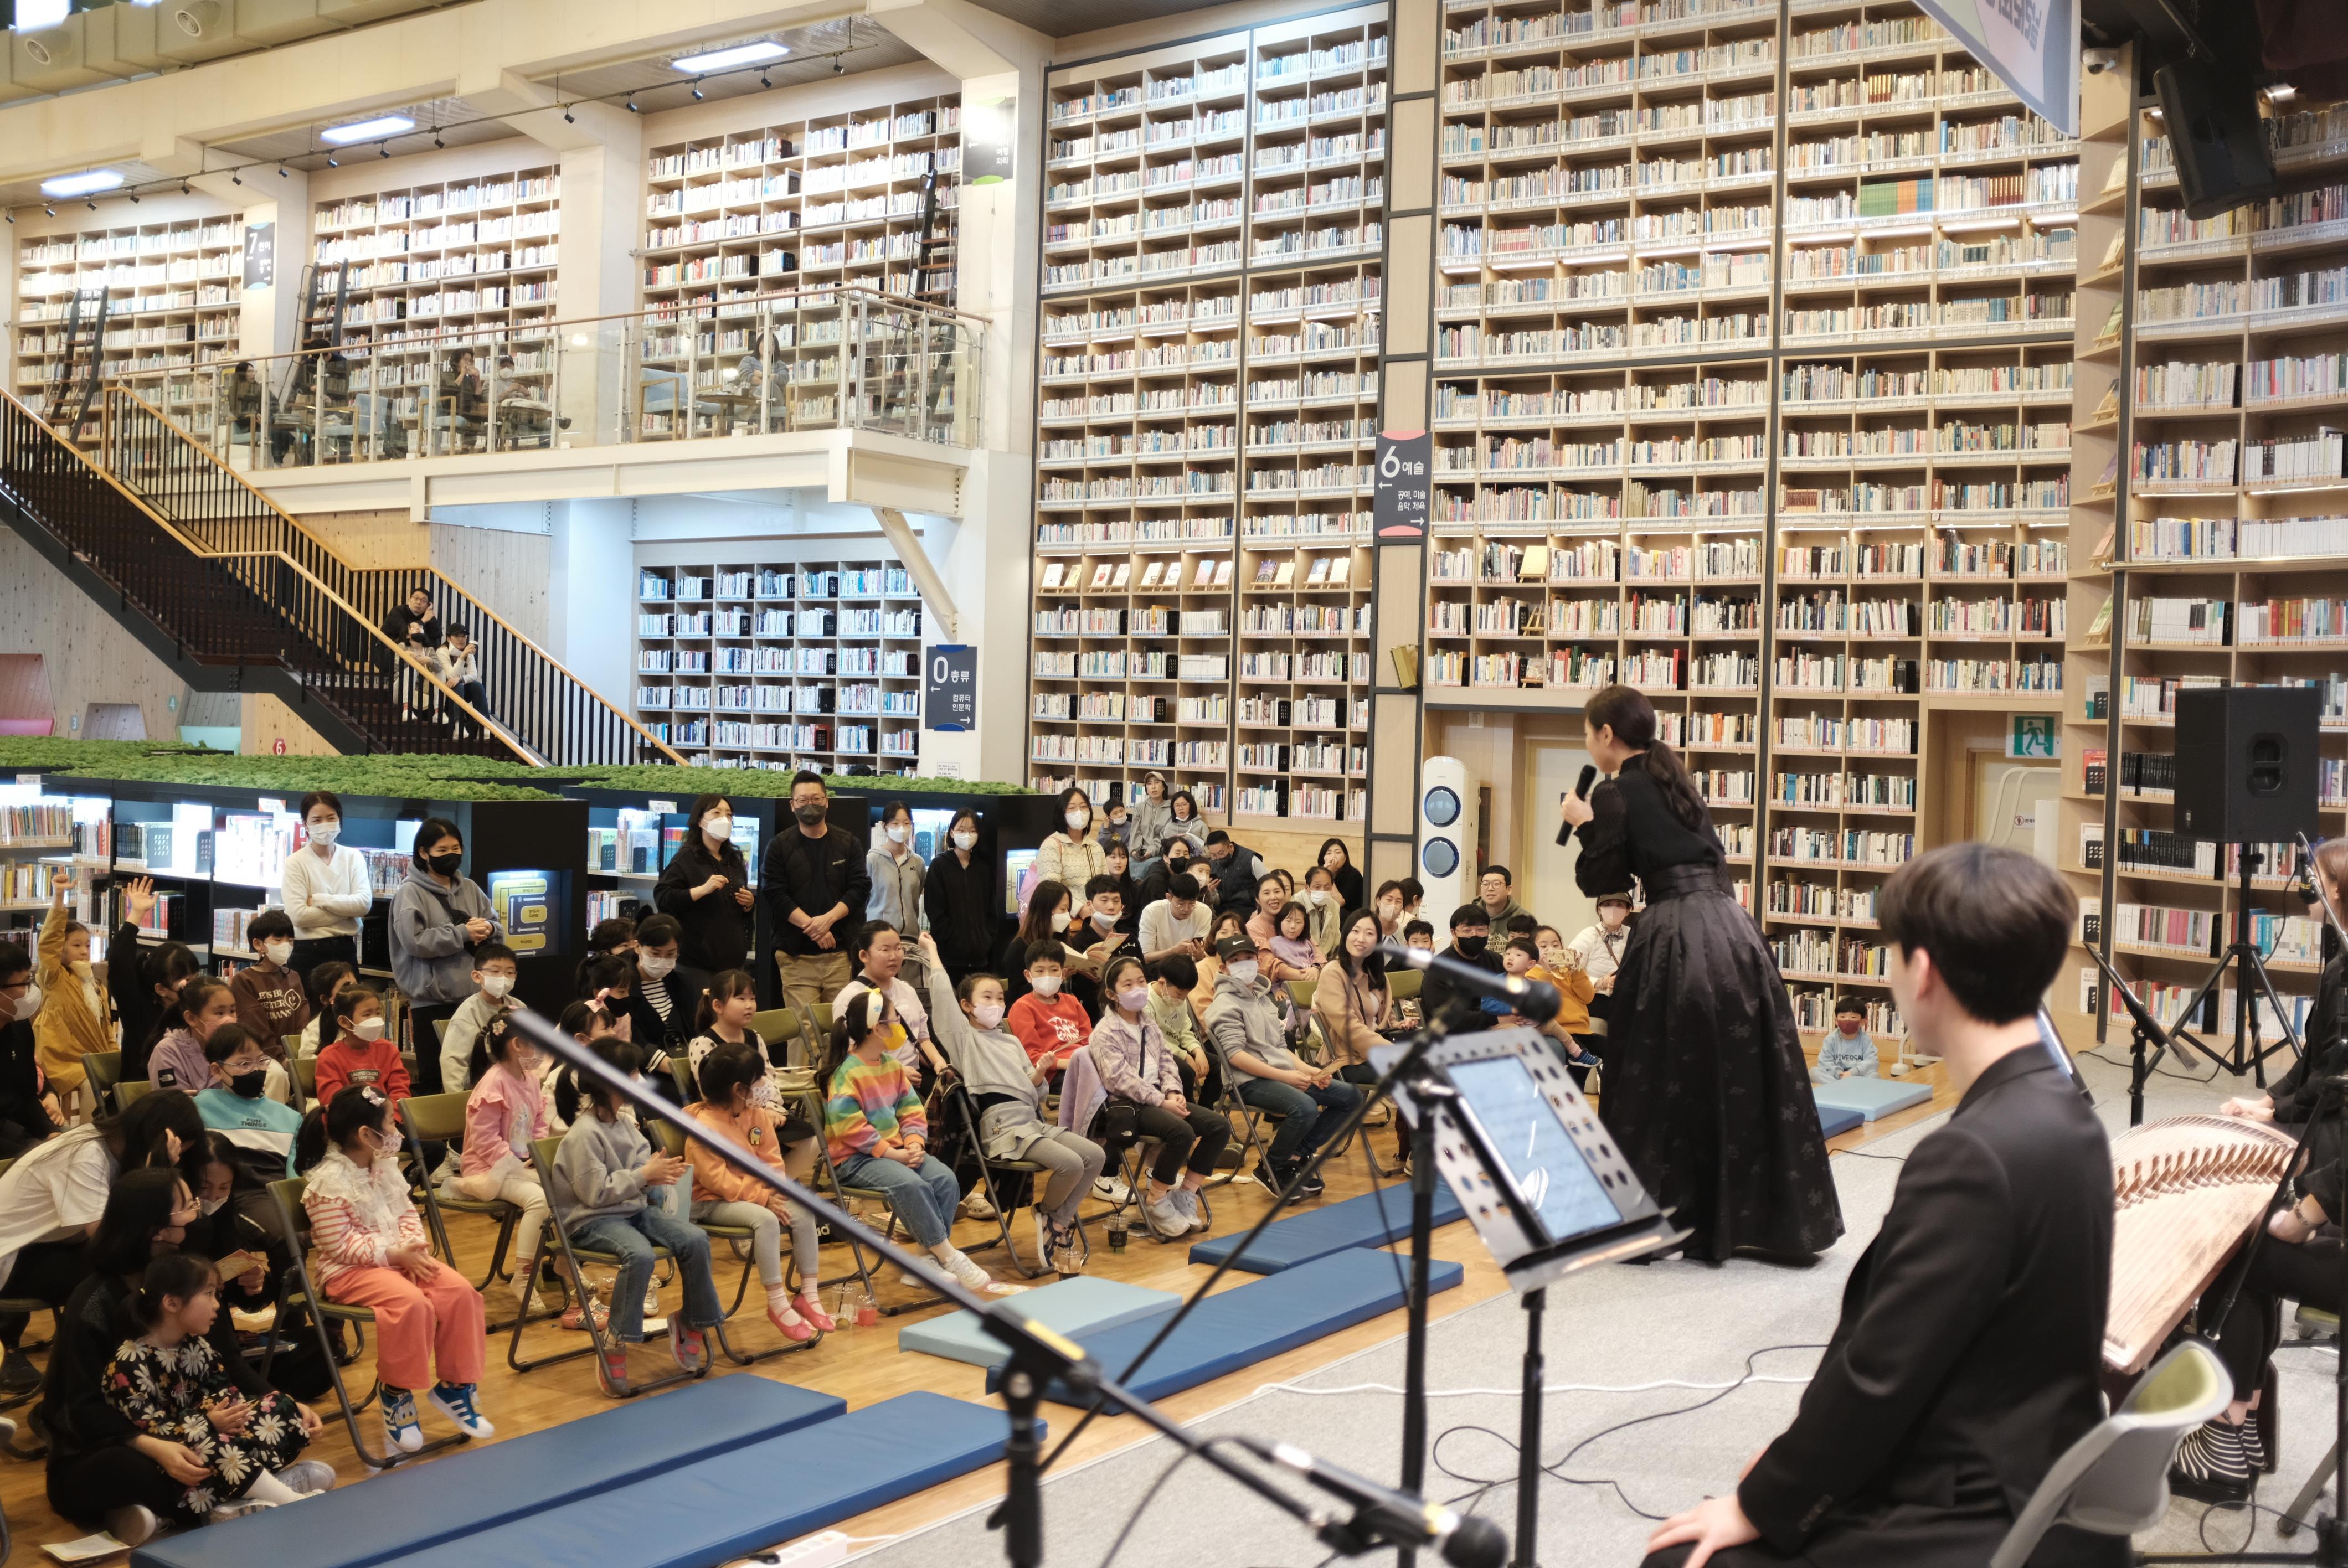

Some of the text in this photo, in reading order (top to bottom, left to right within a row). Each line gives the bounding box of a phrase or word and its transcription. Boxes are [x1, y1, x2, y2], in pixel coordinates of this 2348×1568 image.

[996, 147, 1008, 156] 여행
[996, 156, 1008, 165] 지리
[249, 233, 258, 254] 7
[1381, 445, 1424, 478] 6 예술
[1398, 489, 1426, 500] 공예, 미술
[1397, 501, 1412, 512] 음악,
[934, 656, 970, 684] 0 총류
[169, 697, 175, 709] 4
[952, 703, 971, 712] 인문학
[73, 718, 77, 729] 3
[276, 741, 282, 756] 6
